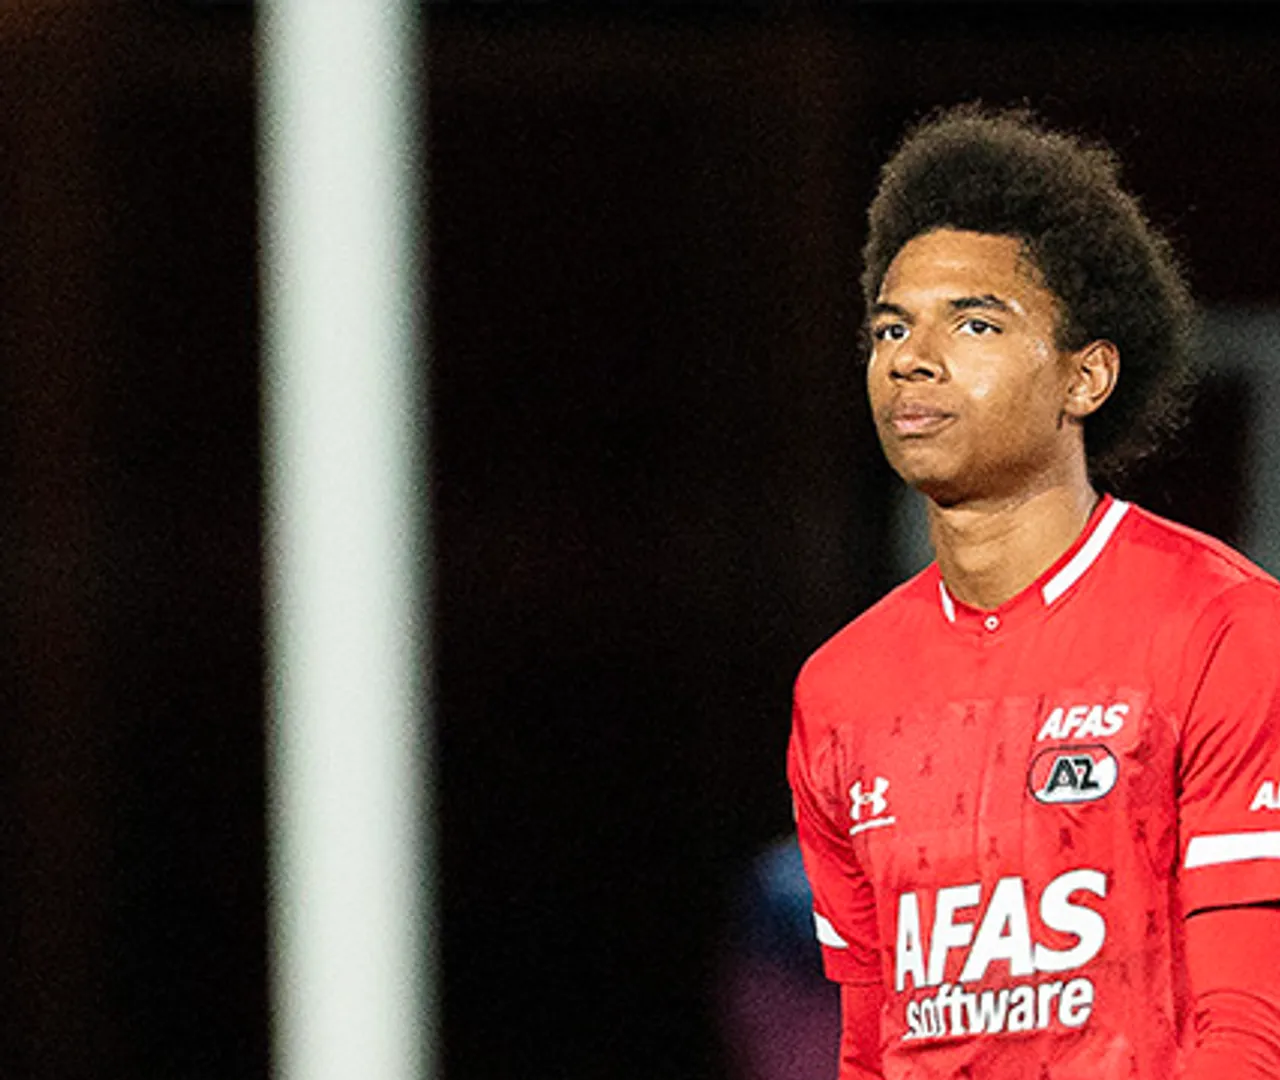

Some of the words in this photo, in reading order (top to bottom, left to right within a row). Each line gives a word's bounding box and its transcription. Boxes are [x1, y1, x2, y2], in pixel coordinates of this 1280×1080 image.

[1037, 703, 1129, 742] AFAS
[1044, 755, 1100, 796] AZ
[896, 867, 1107, 992] AFAS
[902, 977, 1094, 1041] software
